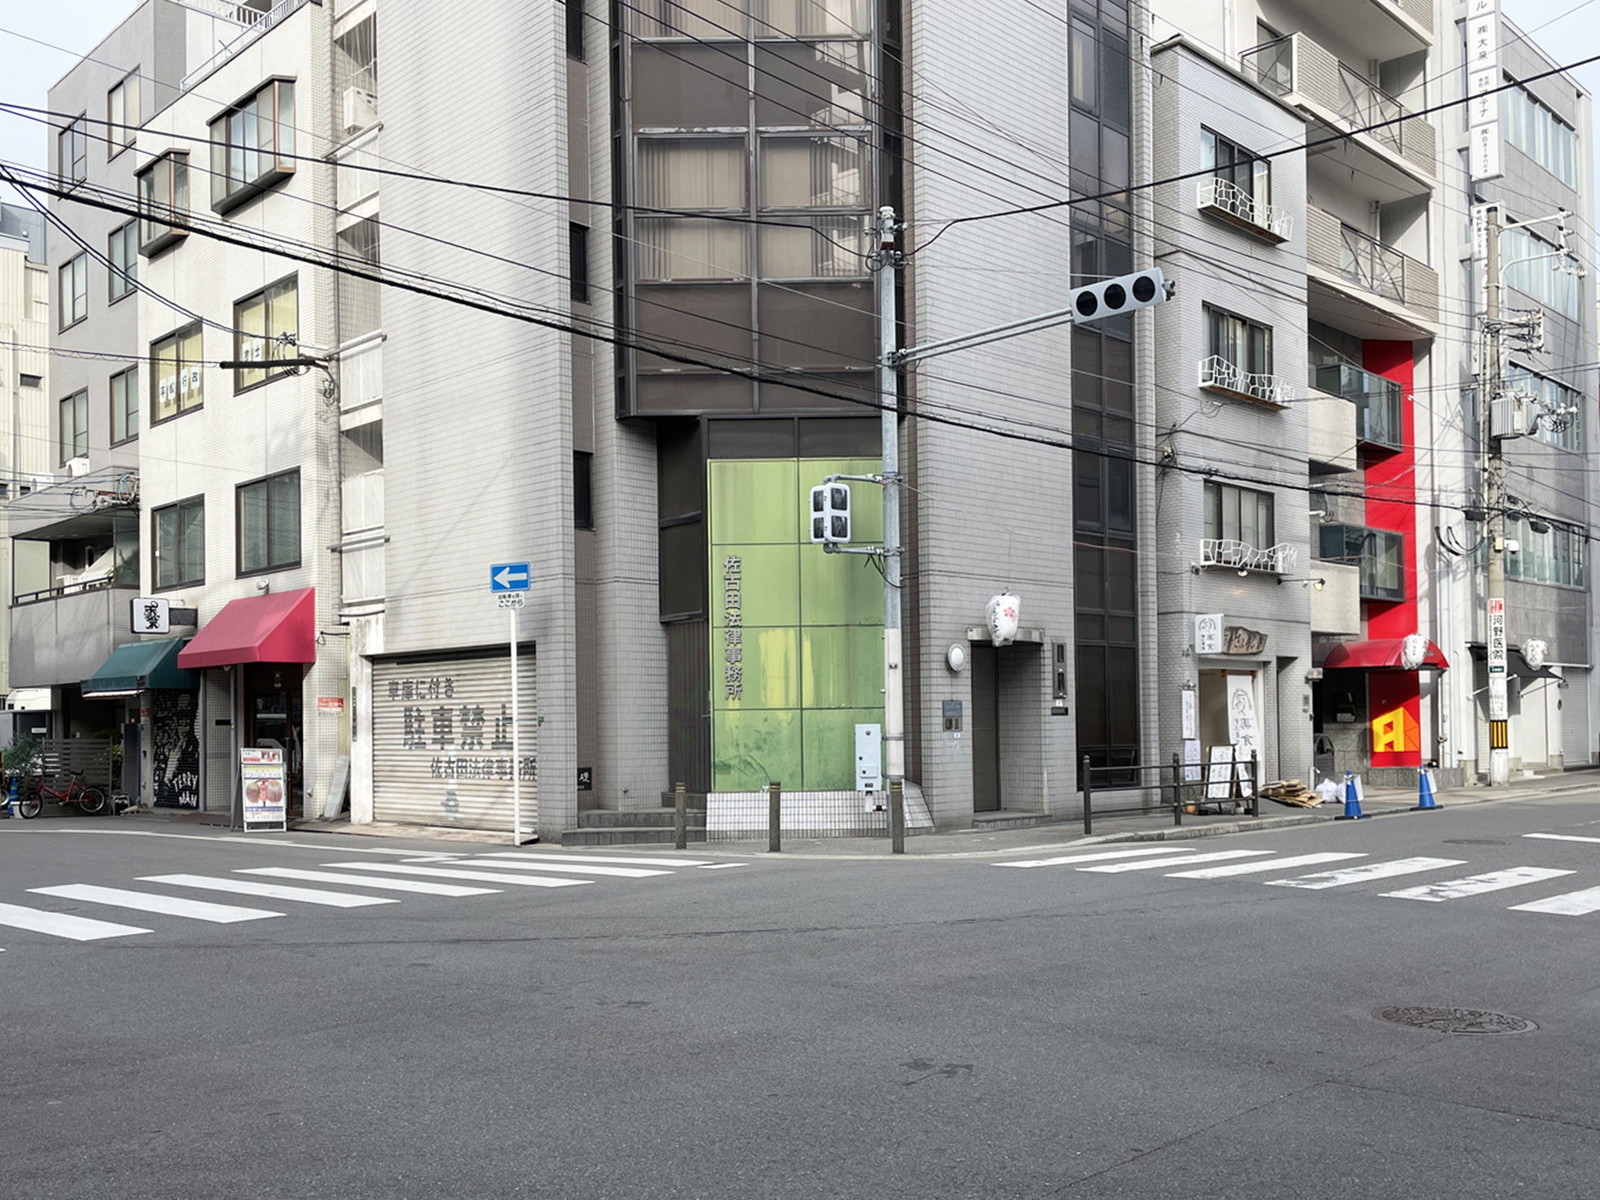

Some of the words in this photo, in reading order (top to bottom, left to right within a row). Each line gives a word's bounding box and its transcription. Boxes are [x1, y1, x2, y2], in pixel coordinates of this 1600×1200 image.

[498, 599, 523, 608] ここから
[724, 556, 743, 700] 佐古田法律事務所
[1493, 614, 1504, 660] 河野医院
[403, 705, 514, 751] 駐車禁止
